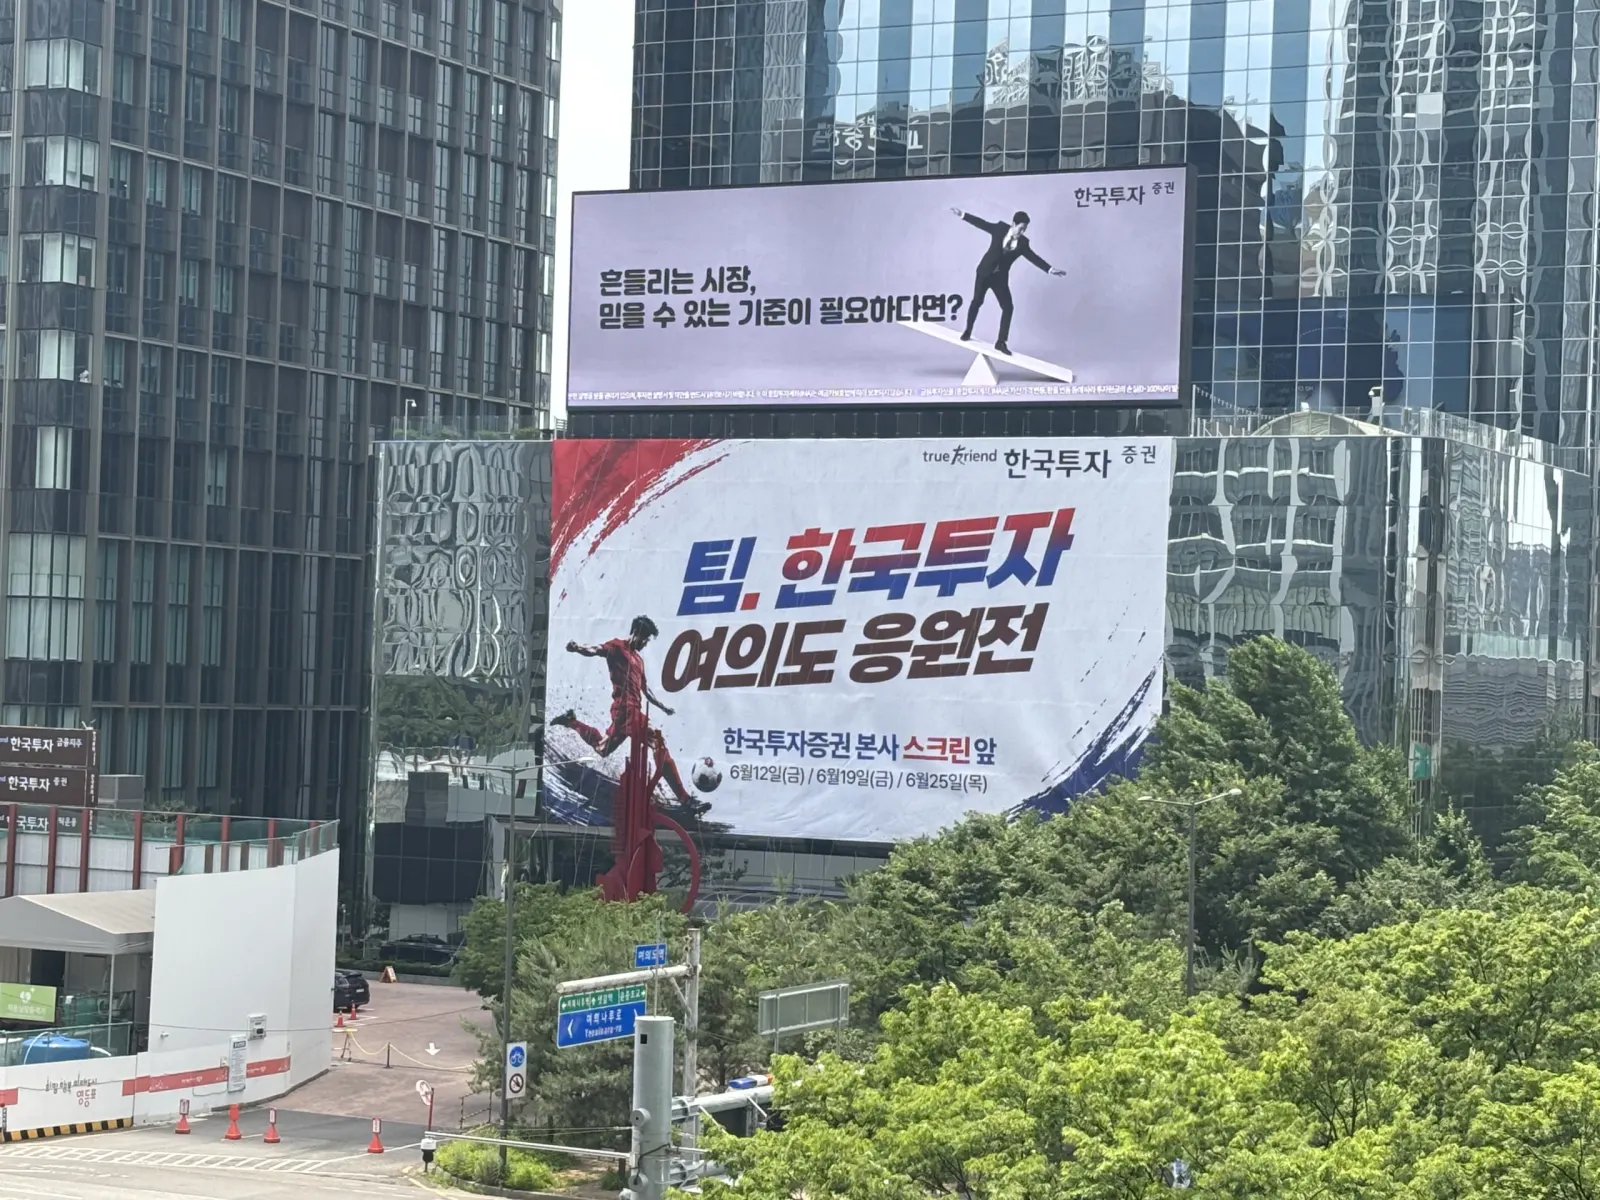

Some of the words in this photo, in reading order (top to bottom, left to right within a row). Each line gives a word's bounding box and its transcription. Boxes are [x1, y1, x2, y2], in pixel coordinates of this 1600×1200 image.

[1074, 186, 1146, 208] 한국투자
[1152, 181, 1176, 195] 증권
[599, 268, 694, 297] 흔들리는
[700, 265, 756, 296] 시장,
[600, 302, 645, 330] 믿을
[652, 301, 676, 329] 수
[683, 298, 731, 328] 있는
[738, 297, 811, 327] 기준이
[819, 294, 963, 325] 필요하다면?
[1004, 448, 1112, 479] 한국투자
[1120, 445, 1157, 465] 증권
[676, 536, 761, 616] 팀.
[775, 507, 1077, 610] 한국투자
[661, 618, 847, 694] 여의도
[849, 602, 1051, 685] 응원전
[10, 735, 54, 753] 한국투자
[56, 737, 83, 748] 금융지주
[723, 727, 851, 760] 한국투자증권
[855, 732, 899, 762] 본사
[903, 735, 971, 766] 스크린
[973, 736, 998, 766] 앞
[8, 775, 51, 792] 한국투자
[53, 776, 68, 787] 증권
[730, 764, 805, 786] 6월12일(금)
[816, 767, 894, 789] 6월19일(금)
[905, 771, 989, 794] 6월25일(목)
[586, 1008, 623, 1026] 여의나루로
[76, 1088, 97, 1108] 영등포
